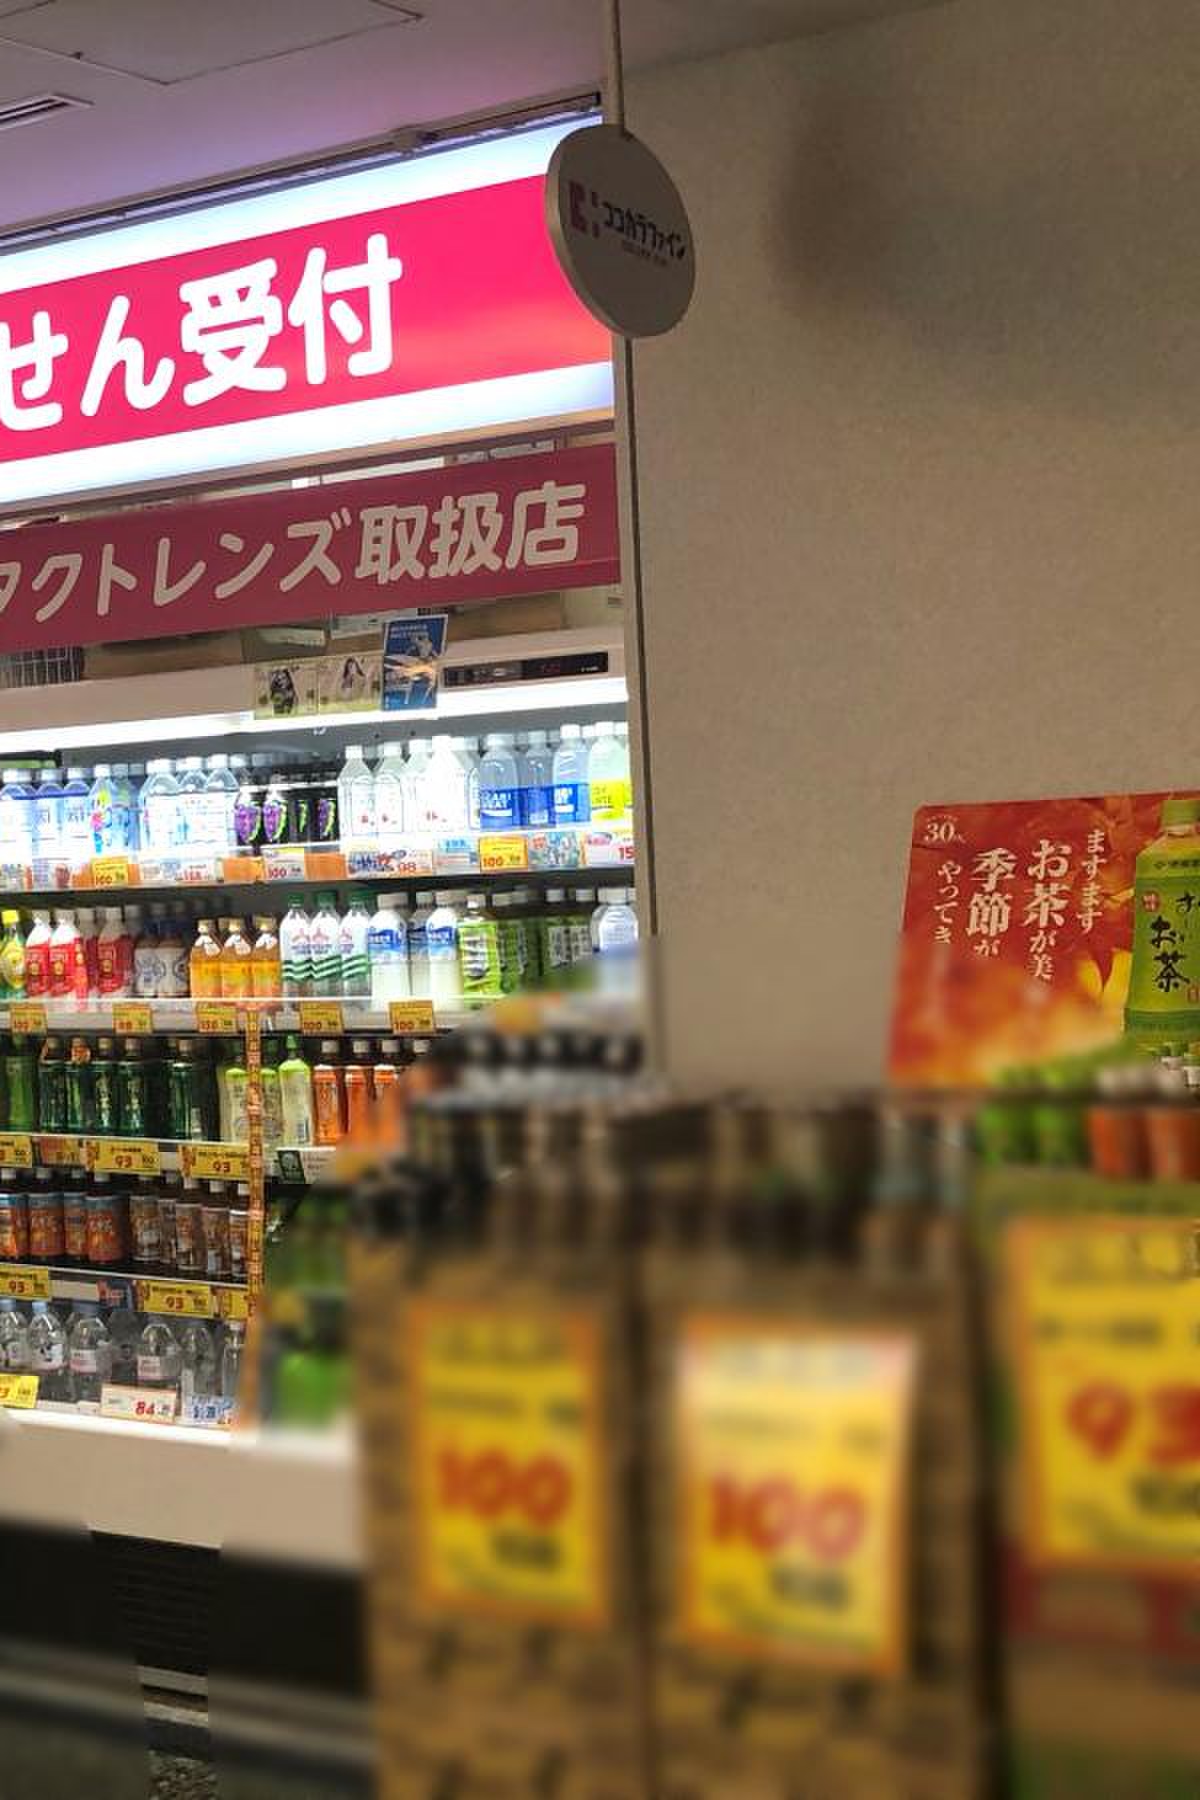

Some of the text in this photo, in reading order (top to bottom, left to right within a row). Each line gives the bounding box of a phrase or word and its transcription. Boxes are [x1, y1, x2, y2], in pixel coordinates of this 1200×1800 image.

[602, 201, 686, 260] ココカラファイン
[965, 847, 1018, 957] 季節が
[1076, 828, 1107, 934] ますます
[1150, 915, 1190, 992] お茶
[115, 1155, 133, 1168] 93
[212, 1160, 231, 1173] 93
[165, 1296, 184, 1310] 93
[135, 1402, 155, 1415] 84
[434, 1446, 572, 1529] 100
[708, 1474, 868, 1564] 100
